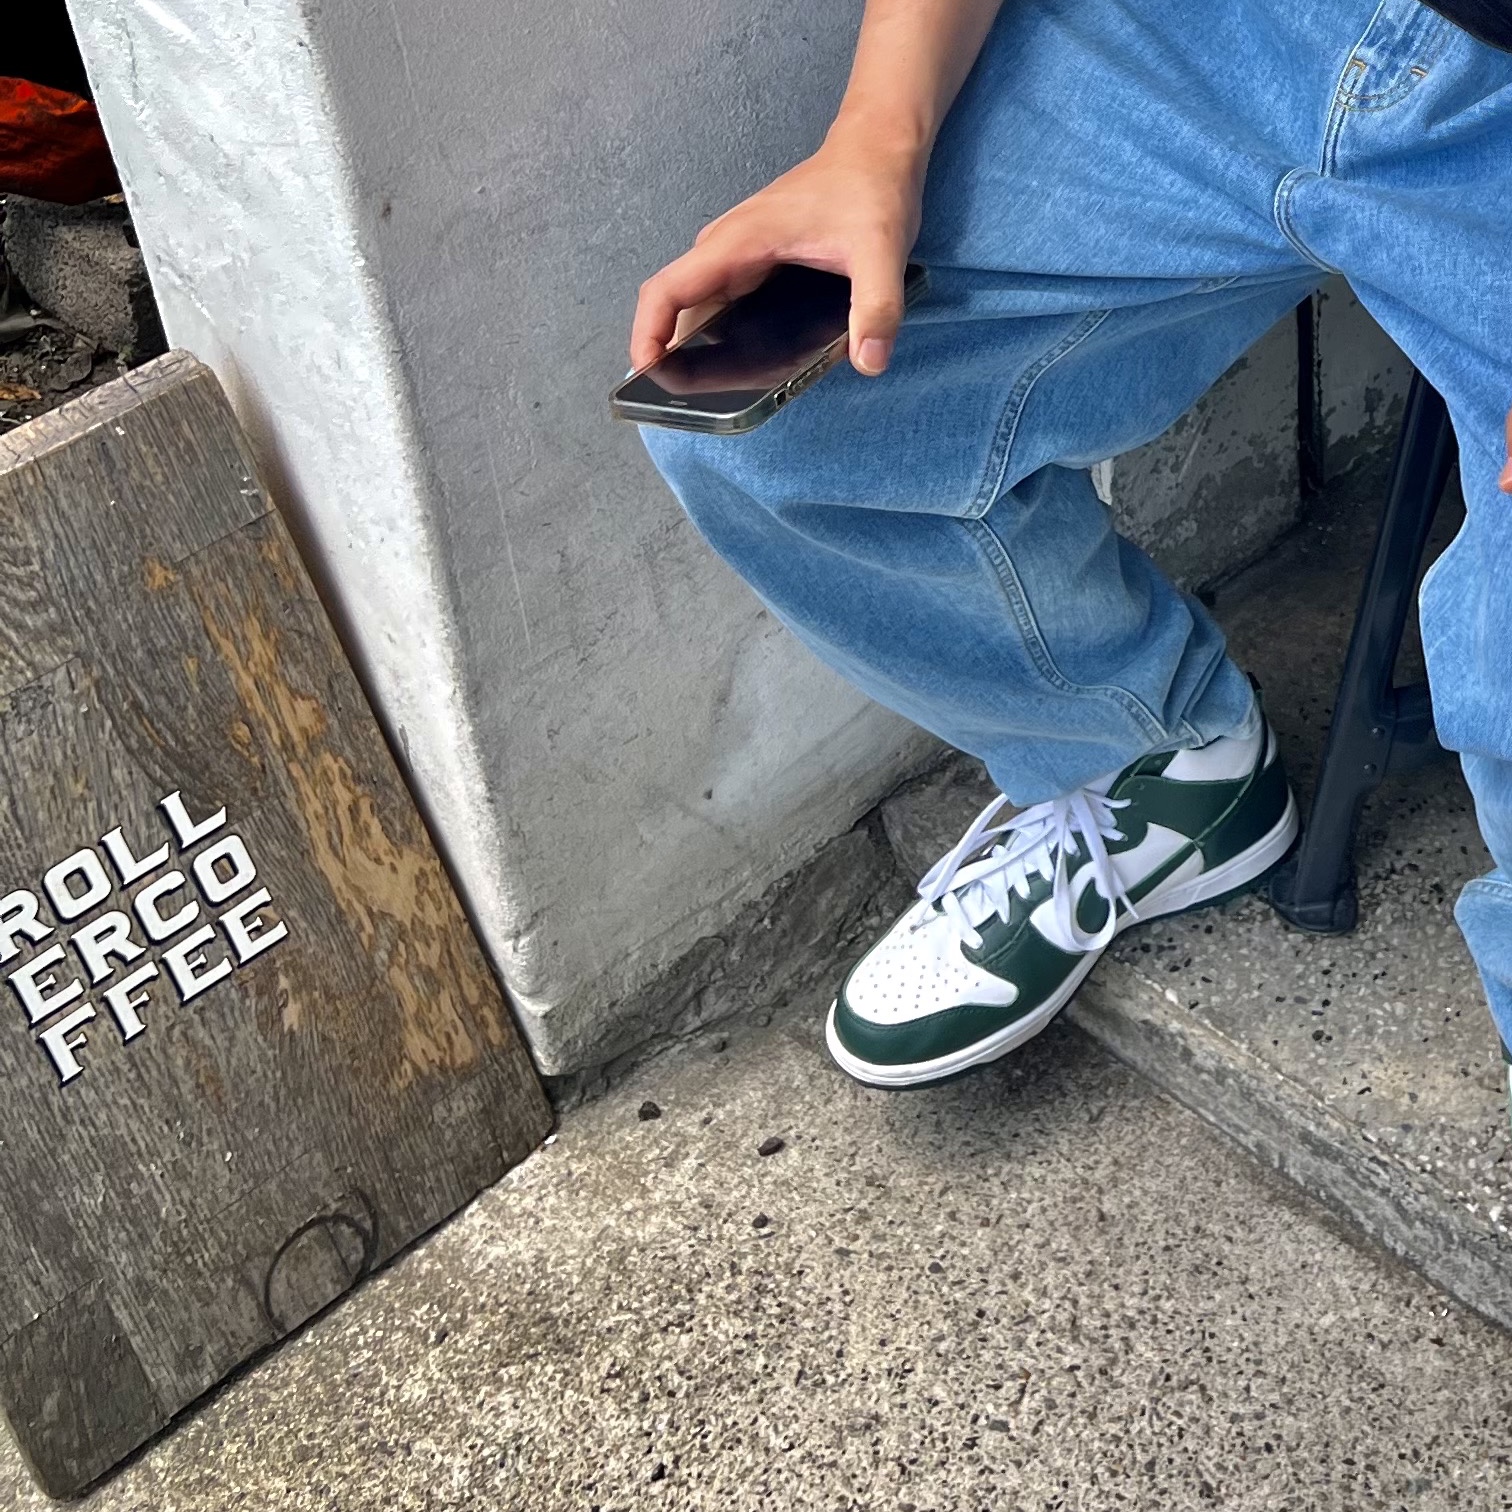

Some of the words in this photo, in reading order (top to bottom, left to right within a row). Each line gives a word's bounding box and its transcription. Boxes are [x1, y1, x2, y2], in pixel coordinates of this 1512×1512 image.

[0, 790, 227, 963] ROLL
[8, 834, 257, 1024] ERCO
[39, 887, 289, 1083] FFEE
